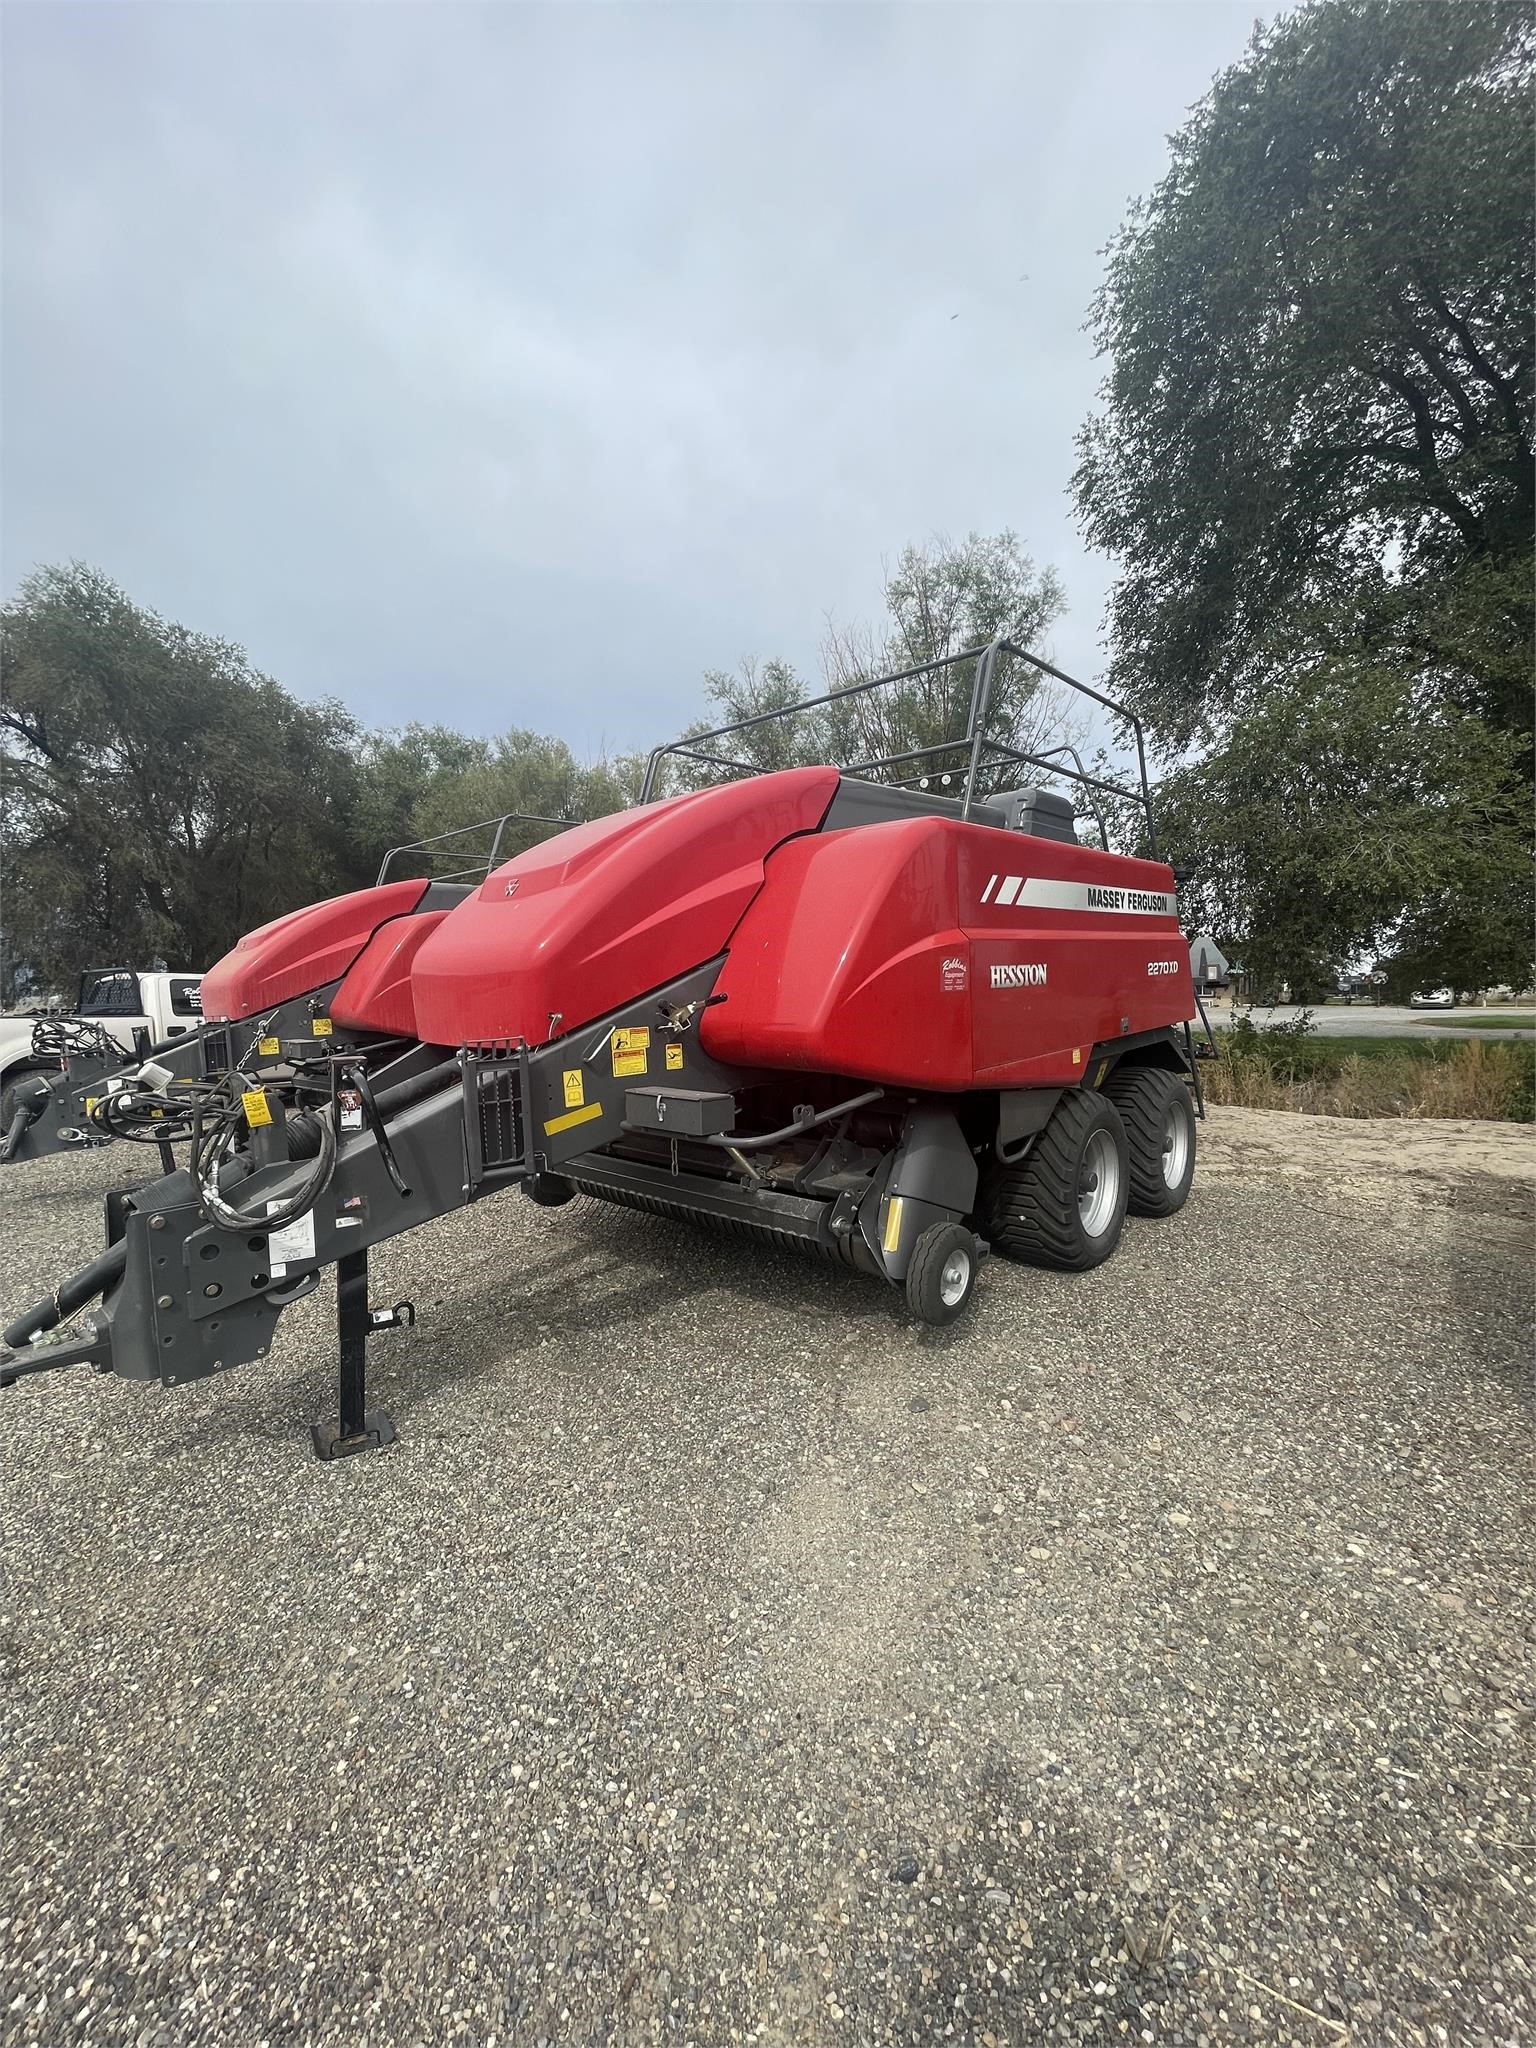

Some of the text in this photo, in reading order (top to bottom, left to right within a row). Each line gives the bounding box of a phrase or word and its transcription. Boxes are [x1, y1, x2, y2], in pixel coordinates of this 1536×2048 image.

[1087, 888, 1168, 913] MASSEY FERGUSON
[989, 963, 1048, 989] HESSTON
[1147, 960, 1179, 976] 2270XD
